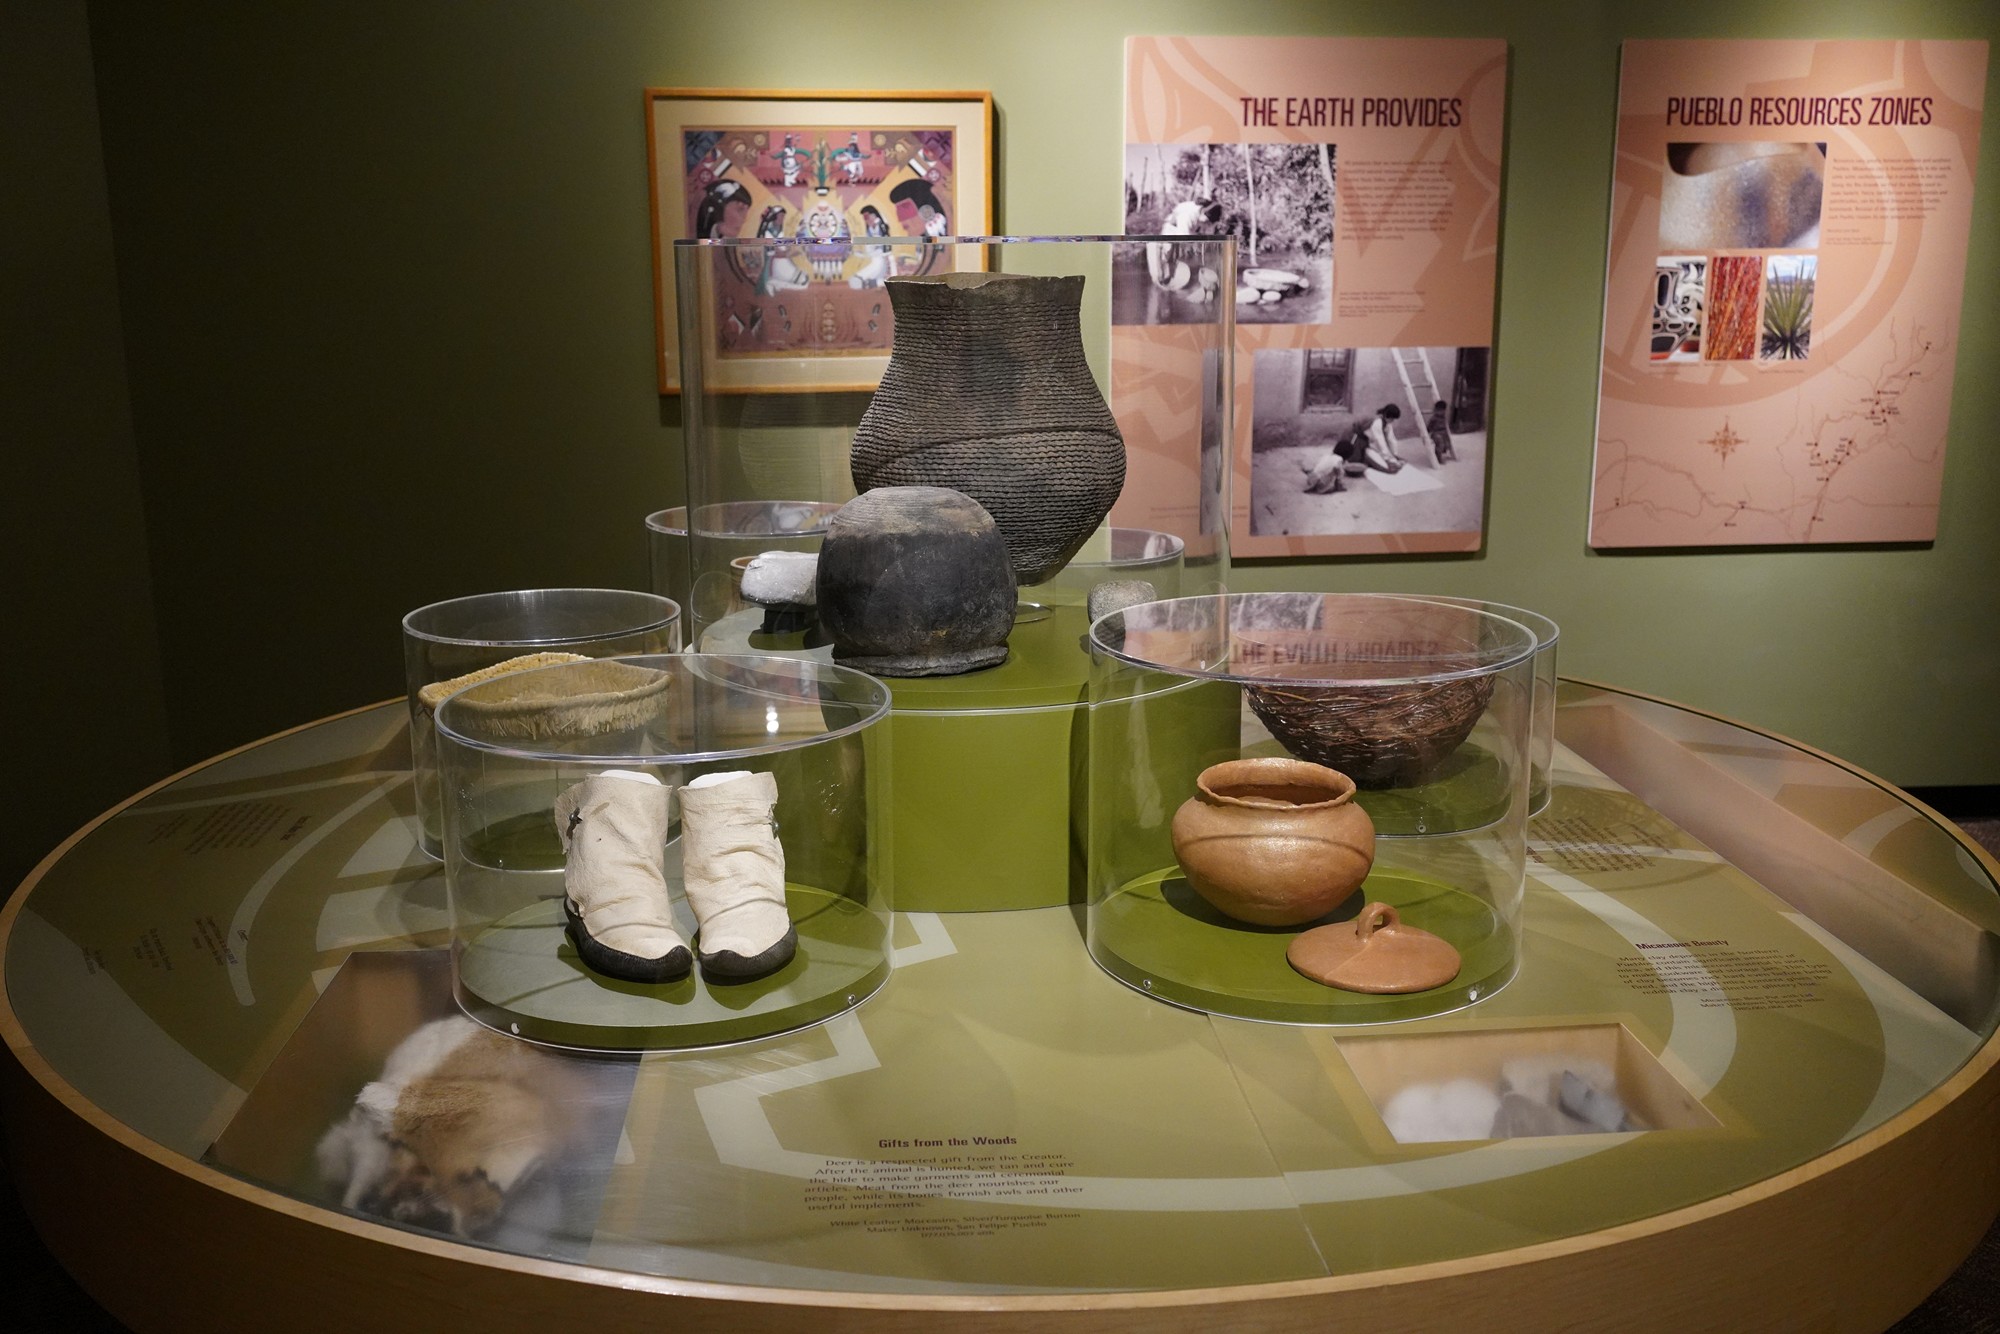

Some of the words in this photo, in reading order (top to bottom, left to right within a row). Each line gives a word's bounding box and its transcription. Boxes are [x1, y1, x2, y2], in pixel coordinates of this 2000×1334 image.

[1240, 96, 1279, 127] THE
[1285, 96, 1354, 127] EARTH
[1361, 96, 1462, 127] PROVIDES
[1666, 96, 1743, 127] PUEBLO
[1749, 96, 1863, 126] RESOURCES
[1868, 96, 1933, 126] ZONES
[1635, 942, 1692, 950] Micaceous
[1691, 939, 1729, 947] Beauty
[1668, 952, 1703, 960] deposits
[1710, 984, 1760, 992] distinctive
[878, 1139, 910, 1149] Gifts
[914, 1138, 943, 1147] from
[948, 1137, 968, 1147] the
[972, 1136, 1017, 1146] Woods
[825, 1159, 852, 1167] Deer
[880, 1157, 936, 1166] respected
[940, 1156, 961, 1164] gift
[1021, 1153, 1066, 1161] Creator.
[872, 1166, 912, 1174] animal
[929, 1164, 975, 1172] hunted,
[809, 1177, 828, 1185] the
[914, 1173, 970, 1181] garments
[1000, 1170, 1064, 1178] ceremonial
[978, 1180, 1035, 1188] nourishes
[804, 1194, 847, 1203] people,
[907, 1191, 943, 1199] bones
[948, 1189, 991, 1197] furnish
[1052, 1186, 1084, 1194] other
[807, 1203, 845, 1211] useful
[850, 1201, 925, 1210] implements.
[830, 1219, 859, 1227] White
[863, 1218, 898, 1226] Leather
[901, 1225, 953, 1233] Unknown,
[979, 1222, 1008, 1230] Felipe
